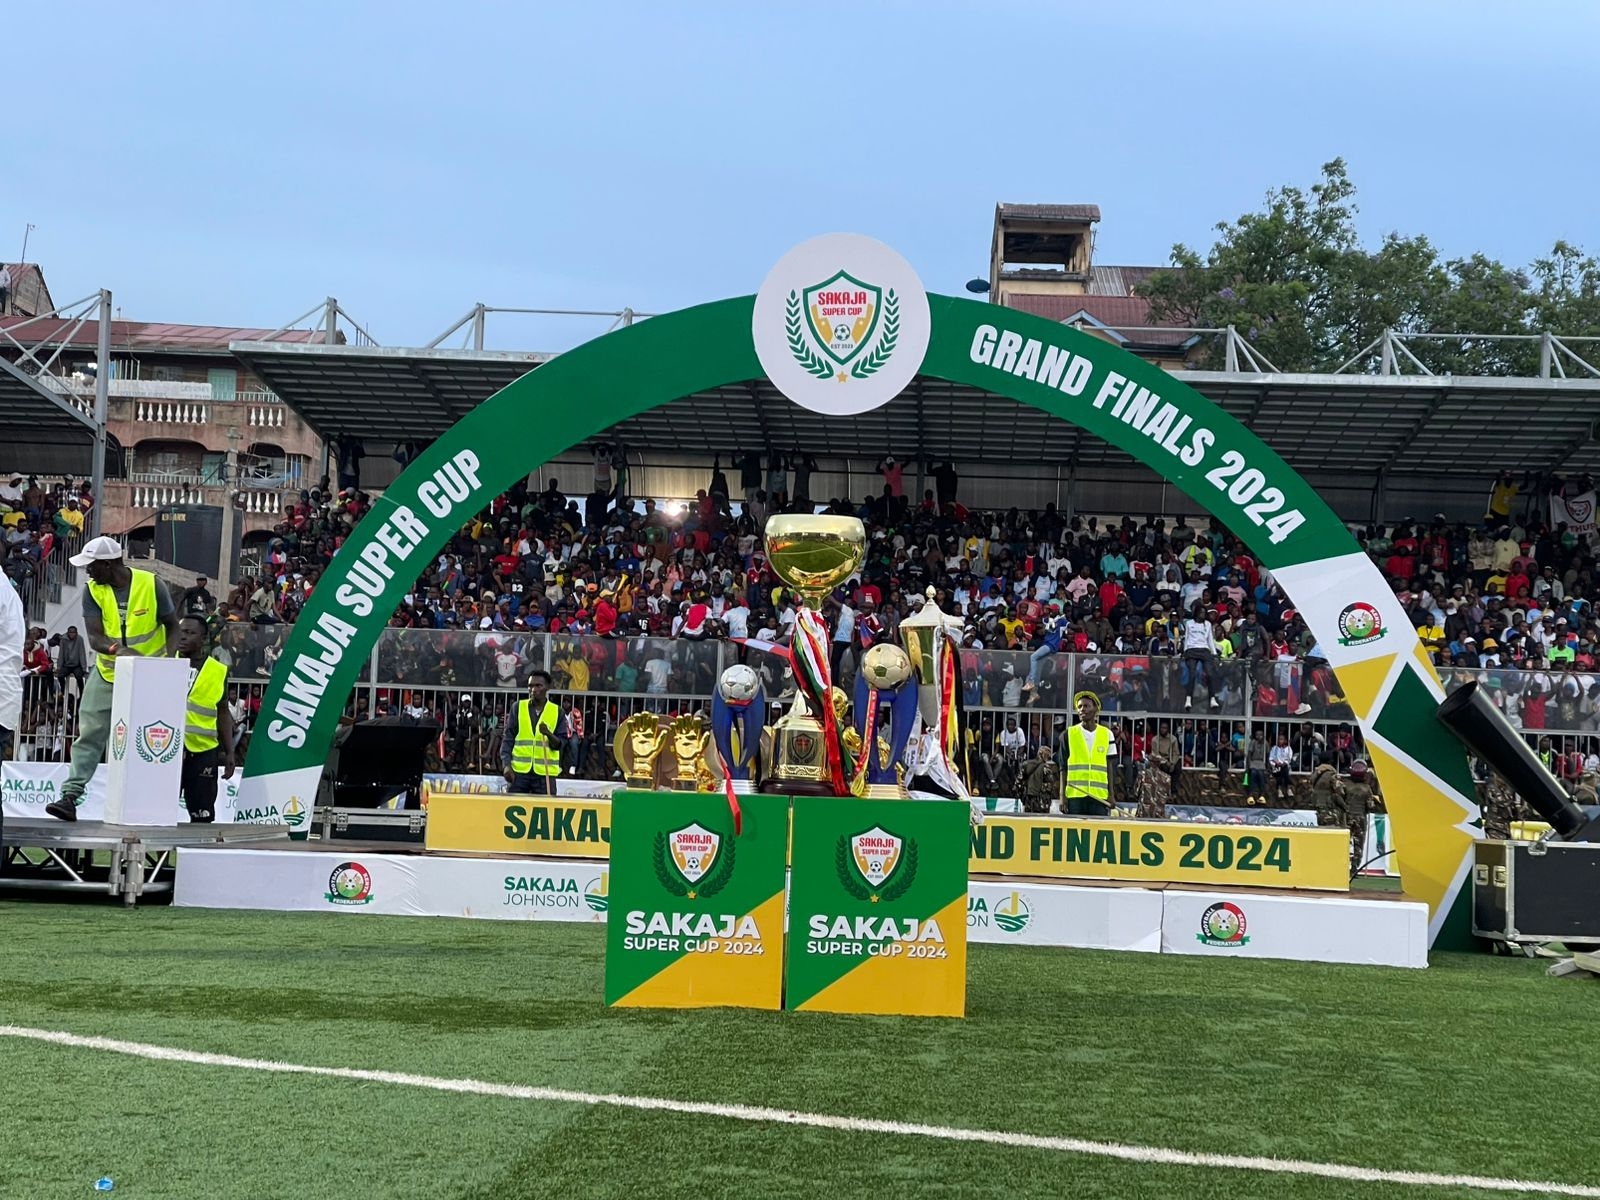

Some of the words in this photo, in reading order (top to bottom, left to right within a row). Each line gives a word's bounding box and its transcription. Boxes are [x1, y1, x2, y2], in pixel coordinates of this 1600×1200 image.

[818, 291, 867, 305] SAKAJA
[822, 307, 846, 316] SUPER
[847, 307, 862, 316] CUP
[969, 324, 1093, 396] GRAND
[1092, 370, 1215, 467] FINALS
[1205, 450, 1306, 545] 2024
[267, 612, 358, 749] SAKAJA
[335, 505, 430, 617] SUPER
[417, 449, 482, 519] CUP
[2, 779, 55, 792] AKAJA
[2, 792, 55, 804] OHNSON
[234, 805, 279, 822] AKAJA
[504, 805, 611, 844] SAKA
[677, 833, 712, 844] SAKAJA
[859, 837, 894, 848] SAKAJA
[1030, 827, 1165, 867] FINALS
[1179, 833, 1291, 873] 2024
[504, 876, 579, 893] SAKAJA
[503, 893, 579, 908] JOHNSON
[625, 910, 761, 939] SAKAJA
[808, 914, 944, 943] SAKAJA
[1203, 908, 1215, 937] FOOTBALL
[1237, 913, 1245, 935] KENYA
[623, 937, 679, 951] SUPER
[684, 939, 720, 953] CUP
[724, 941, 764, 955] 2024
[807, 940, 862, 955] SUPER
[867, 943, 903, 956] CUP
[907, 945, 947, 959] 2024
